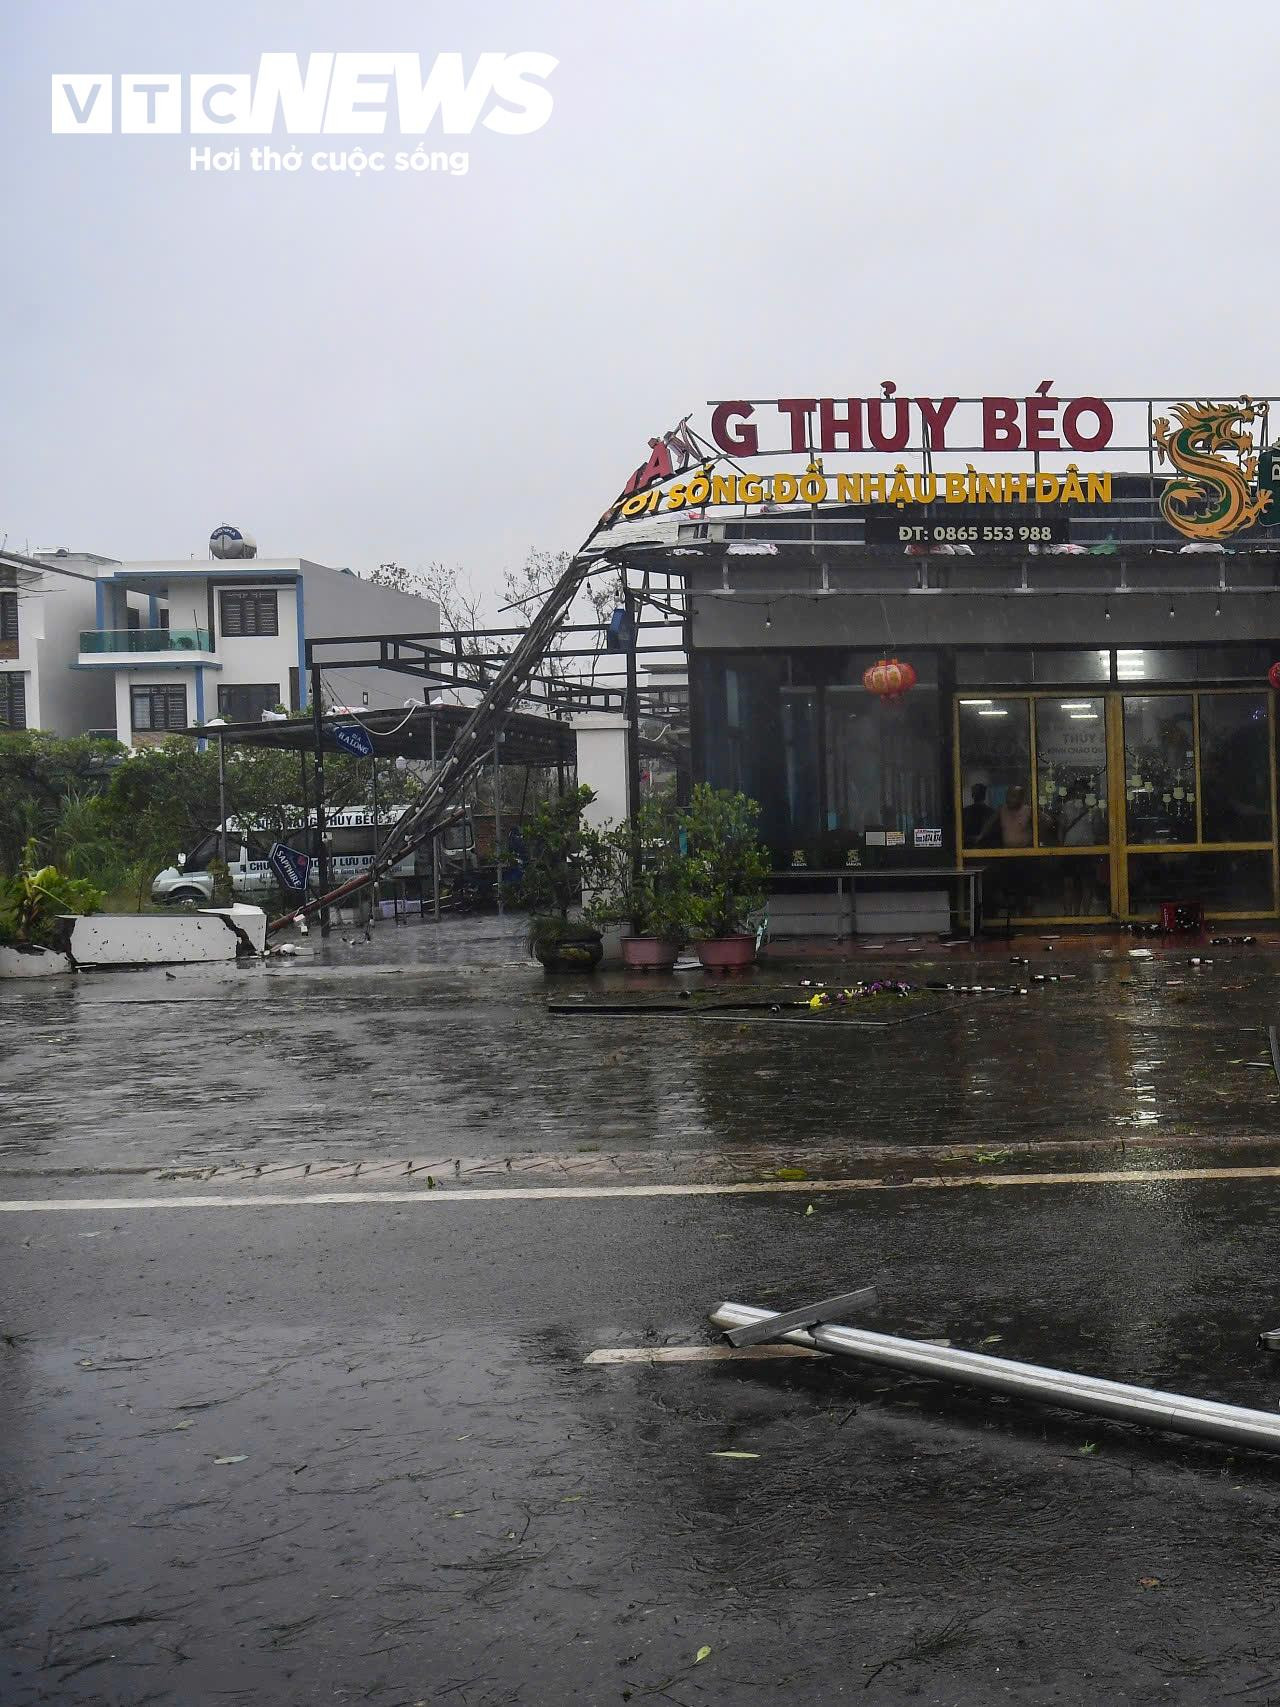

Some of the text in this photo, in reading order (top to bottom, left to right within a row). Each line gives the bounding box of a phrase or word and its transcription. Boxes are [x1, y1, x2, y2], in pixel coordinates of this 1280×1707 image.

[778, 380, 960, 453] THỦY
[983, 380, 1114, 452] BÉO
[774, 458, 828, 504] ĐỒ
[837, 463, 937, 509] NHẬU
[945, 463, 1029, 504] BÌNH
[1035, 463, 1113, 504] DÂN
[899, 526, 1052, 541] ĐT: 0865 553 988
[276, 850, 302, 888] SAPPHIRE
